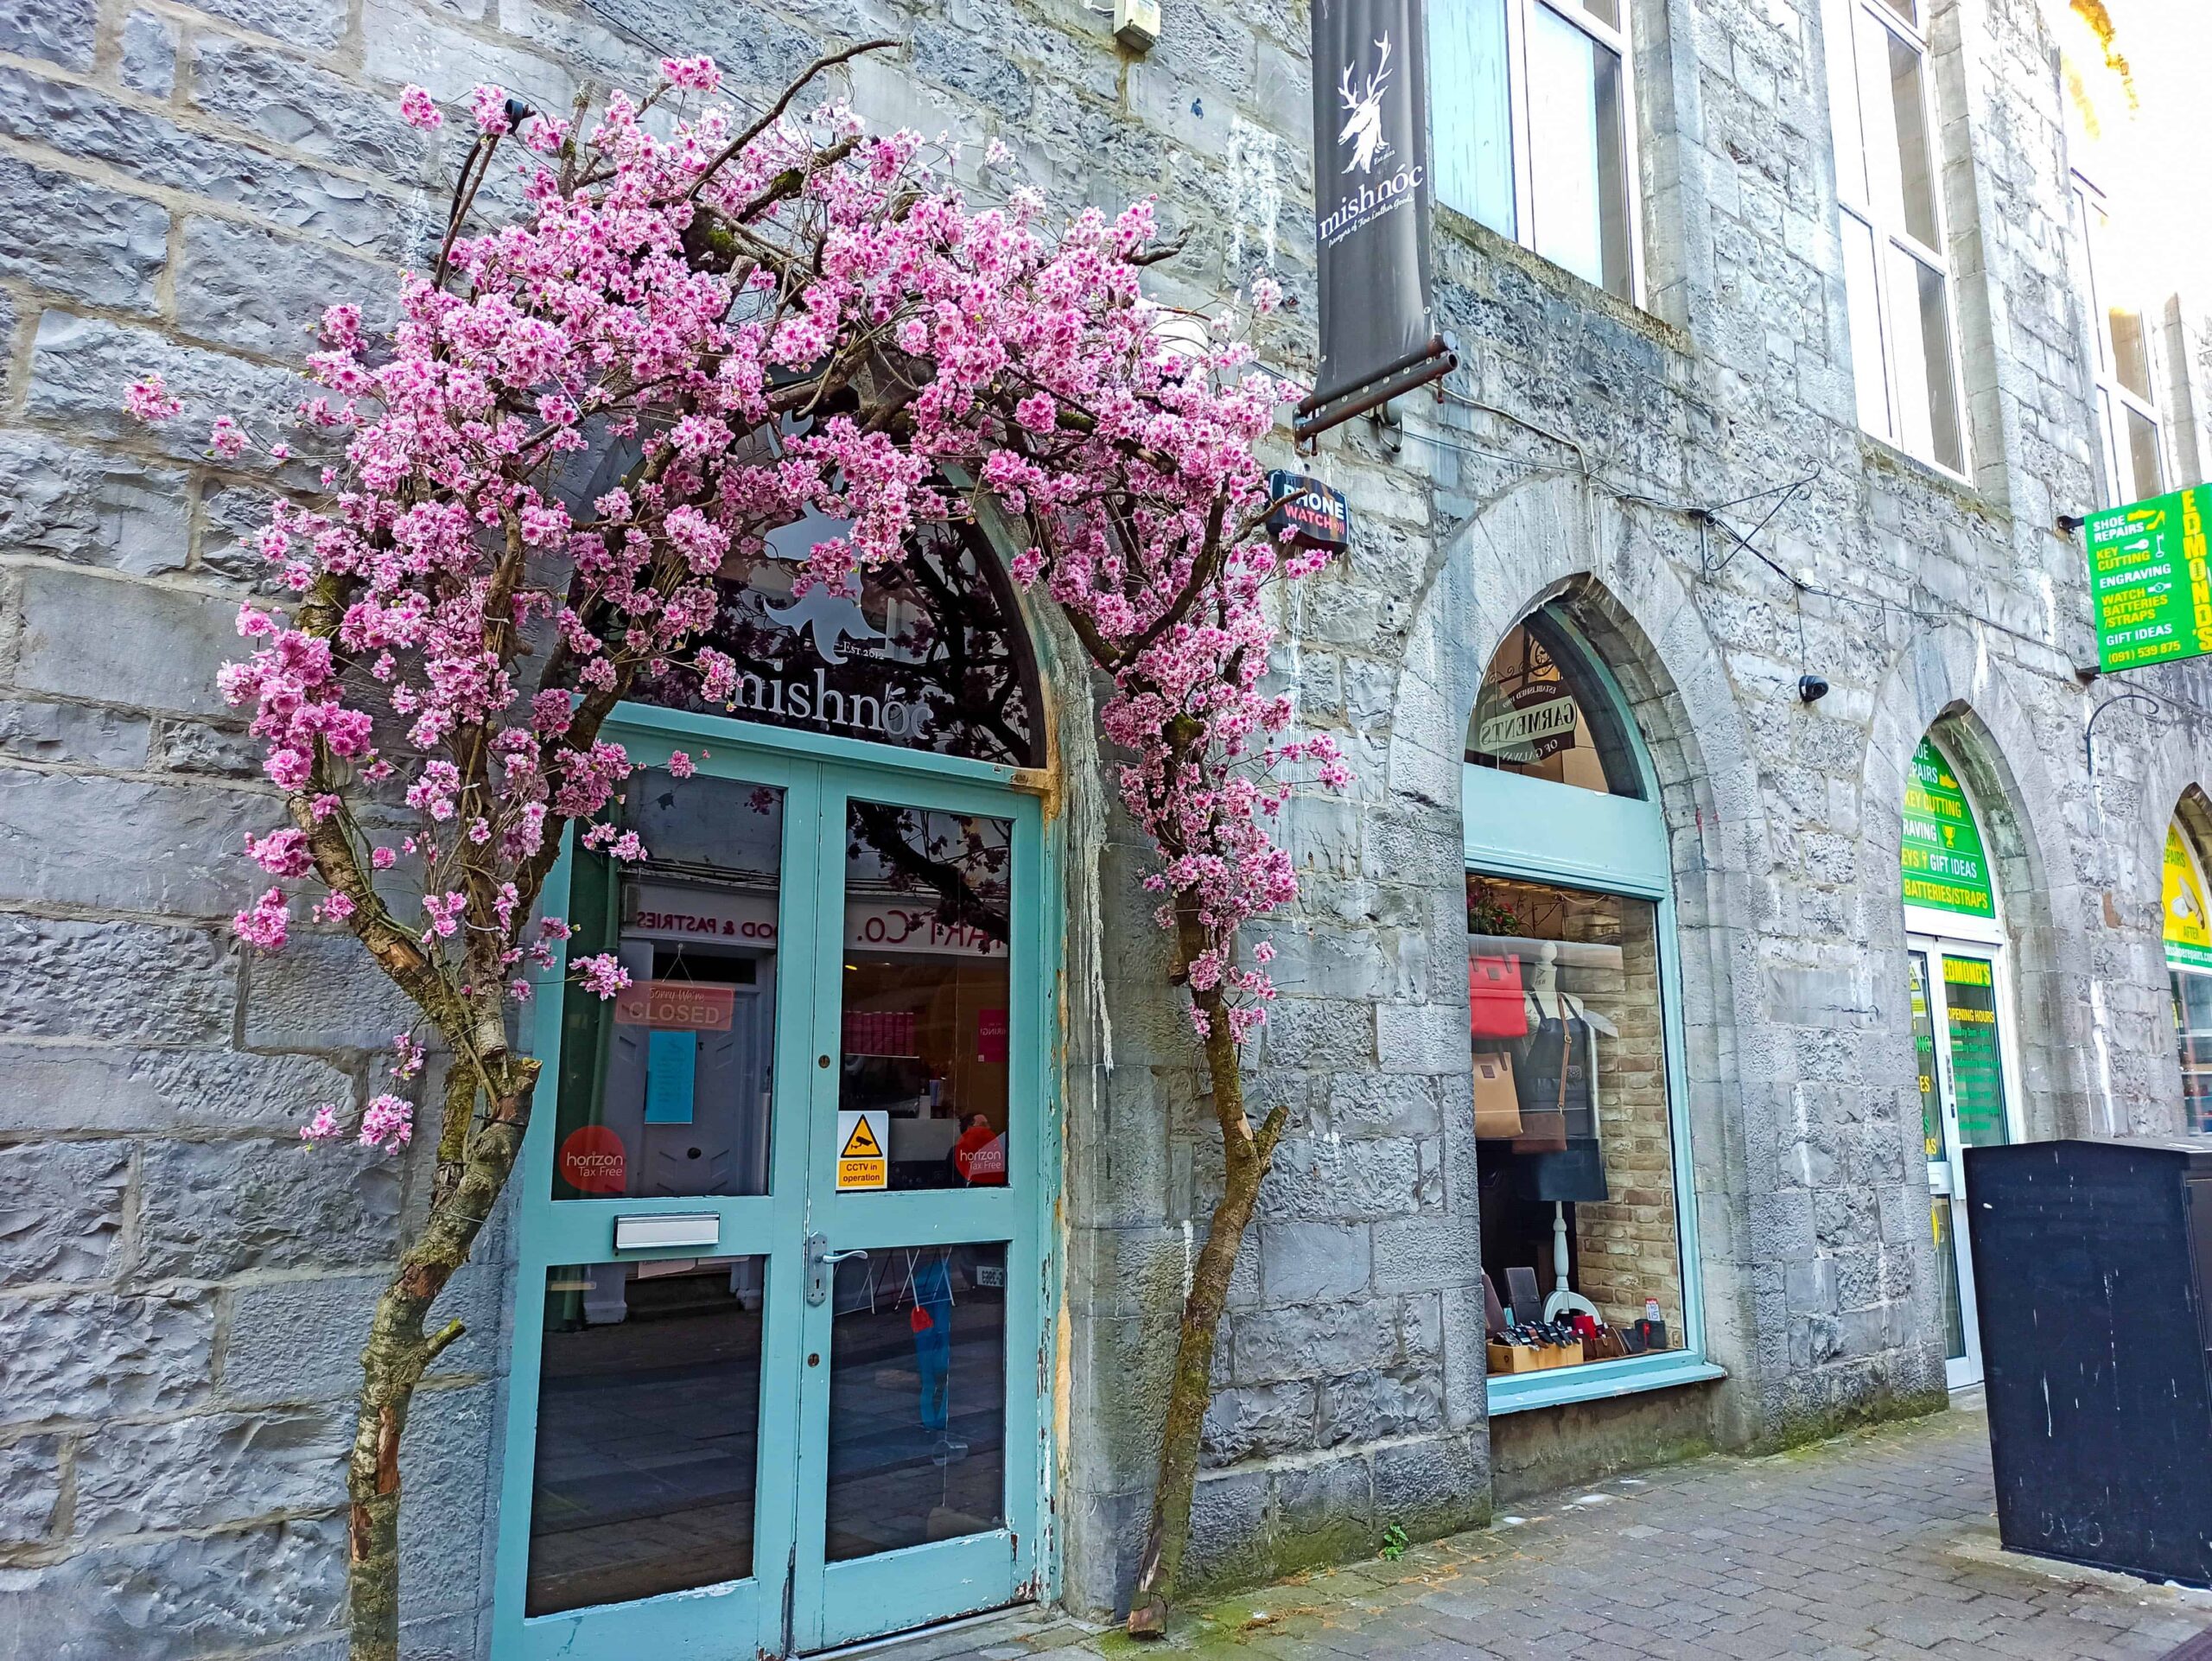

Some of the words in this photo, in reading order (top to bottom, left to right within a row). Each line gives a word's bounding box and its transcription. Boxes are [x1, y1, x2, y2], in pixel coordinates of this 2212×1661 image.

[1319, 163, 1424, 240] mishnóc
[1284, 504, 1332, 530] WATCH
[2093, 514, 2126, 531] SHOE
[2094, 522, 2145, 543] REPAIRS
[2096, 546, 2119, 561] KEY
[2097, 550, 2151, 572] CUTTING
[2100, 563, 2171, 589] ENGRAVING
[2101, 587, 2145, 606] WATCH
[2102, 594, 2169, 618] BATTERIES
[2104, 608, 2157, 629] /STRAPS
[2106, 630, 2132, 646] GIFT
[2135, 623, 2173, 641] IDEAS
[2108, 648, 2135, 665] (091)
[2137, 644, 2158, 659] 539
[2160, 640, 2182, 654] 875
[1904, 789, 1923, 808] KEY
[1924, 794, 1961, 818] CUTTING
[1929, 854, 1949, 874] GIFT
[1950, 858, 1977, 879] IDEAS
[1904, 878, 1988, 909] BATTERIES/STRAPS
[1942, 958, 1992, 986] EDMOND'S
[649, 987, 675, 1002] Sorry
[629, 1001, 720, 1024] CLOSED
[1948, 1007, 1974, 1021] OPENING
[1974, 1009, 1995, 1023] HOURS
[566, 1150, 623, 1167] horizon
[960, 1148, 1001, 1161] horizon
[578, 1166, 596, 1177] Tax
[599, 1166, 623, 1176] Free
[846, 1162, 869, 1172] CCTV
[969, 1161, 982, 1170] Tax
[983, 1161, 1001, 1169] Free
[842, 1174, 880, 1183] operation
